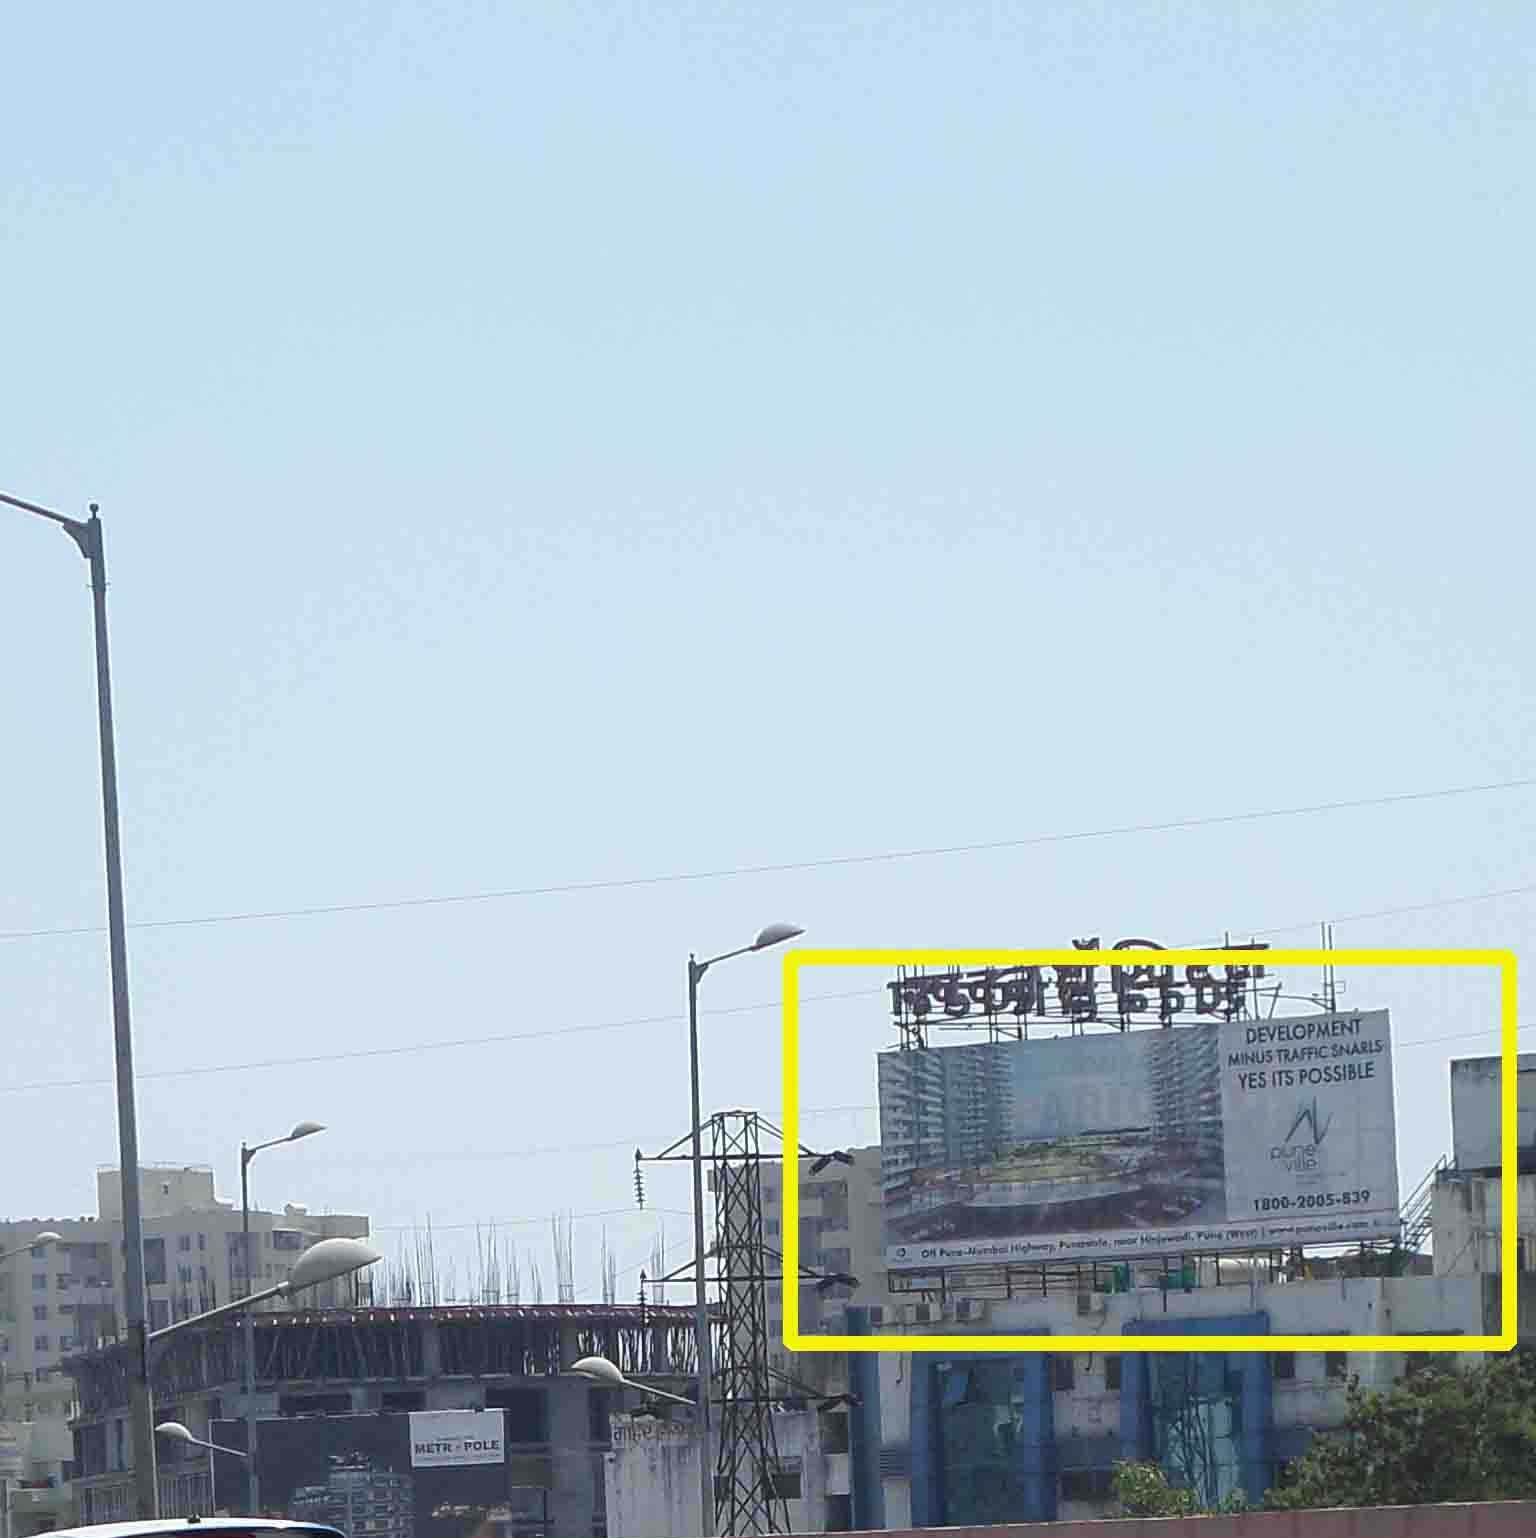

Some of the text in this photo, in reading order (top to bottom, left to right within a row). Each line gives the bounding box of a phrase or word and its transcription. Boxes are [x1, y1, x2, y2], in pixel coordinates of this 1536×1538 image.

[1246, 1019, 1362, 1044] DEVELOPMENT
[1229, 1040, 1384, 1067] MINUS TRAFFIC SNARLS
[1238, 1061, 1375, 1089] YES ITS POSSIBLE
